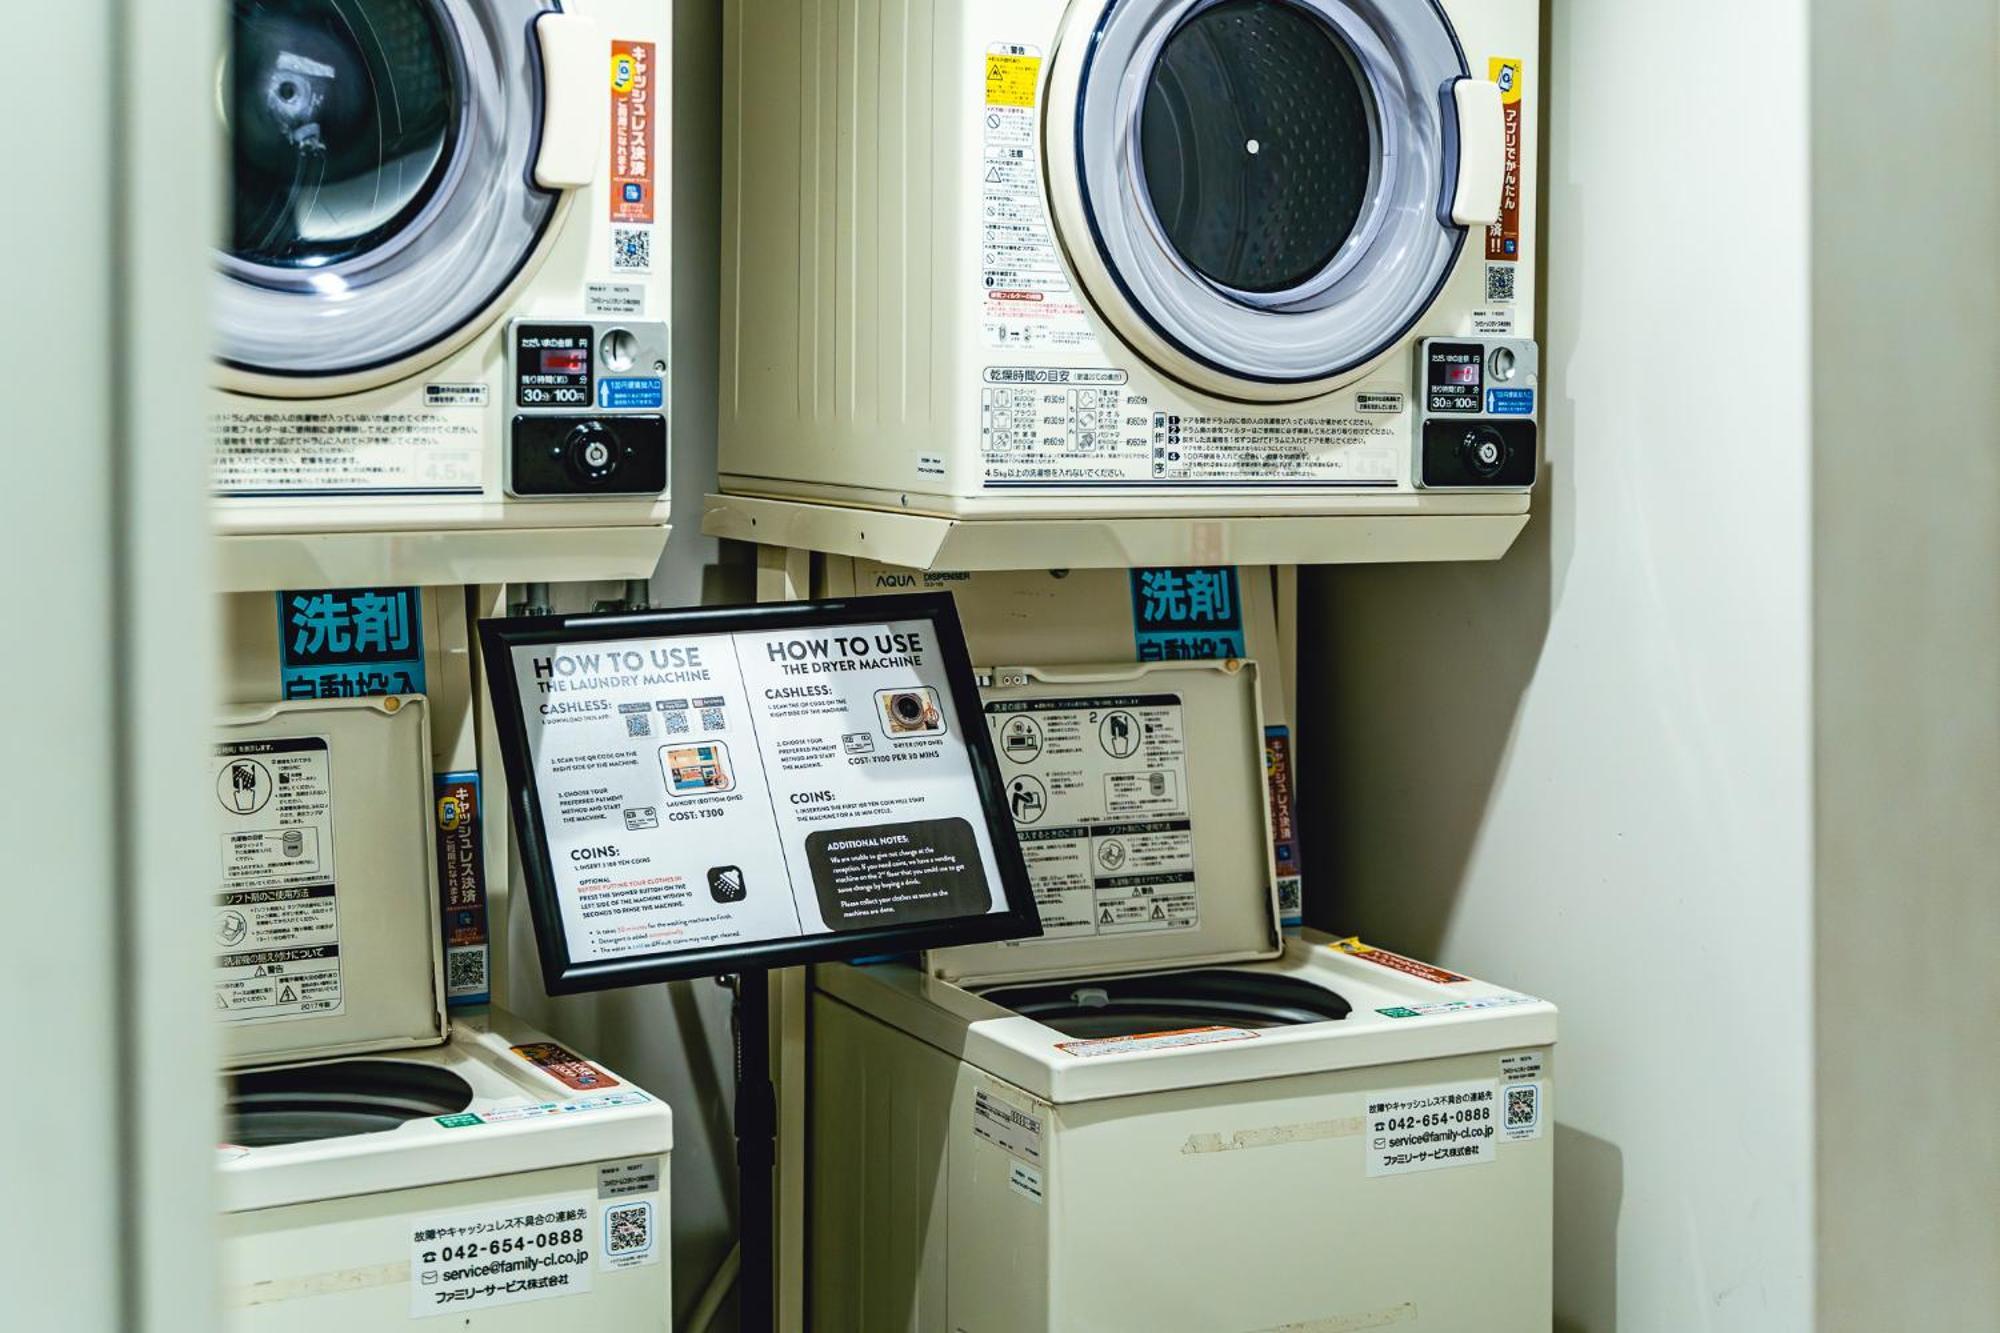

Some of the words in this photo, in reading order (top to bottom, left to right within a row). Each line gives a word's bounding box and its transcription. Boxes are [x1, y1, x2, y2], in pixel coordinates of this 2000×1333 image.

[630, 46, 647, 177] キャッシュレス決済
[1504, 109, 1517, 210] アプリでかんたん
[990, 369, 1070, 382] 乾燥時間の目安
[1154, 417, 1165, 474] 操作順序
[1141, 570, 1231, 621] 洗剤
[292, 592, 410, 656] 洗剤
[767, 640, 828, 661] HOW
[834, 637, 869, 656] TO
[875, 633, 922, 653] USE
[533, 655, 599, 678] HOW
[607, 651, 643, 672] TO
[650, 647, 701, 668] USE
[782, 663, 808, 674] THE
[812, 660, 855, 672] DRYER
[859, 655, 921, 669] MACHINE
[537, 681, 564, 693] THE
[570, 675, 637, 690] LAUNDRY
[643, 669, 710, 684] MACHINE
[765, 685, 831, 699] CASHLESS:
[539, 699, 611, 715] CASHLESS:
[1089, 711, 1098, 723] 2
[790, 790, 834, 804] COINS:
[669, 811, 697, 821] COST:
[455, 787, 477, 904] キャッシュレス決済
[571, 845, 619, 860] COINS:
[826, 838, 879, 851] ADDITIONAL
[879, 834, 909, 845] NOTES:
[1369, 1090, 1493, 1114] 故障やキャッシュレス不具合の連絡先
[1388, 1107, 1490, 1131] 042-654-0888
[1389, 1125, 1494, 1149] service@family-cl.co.jp
[1383, 1145, 1479, 1167] ファミリーサービス株式会社
[414, 1208, 587, 1243] 故障やキャッシュレス不具合の連絡先
[442, 1228, 584, 1262] 042-654-0888
[443, 1249, 588, 1283] service@family-cl.co.jp
[435, 1274, 569, 1304] ファミリーサービス株式会社
